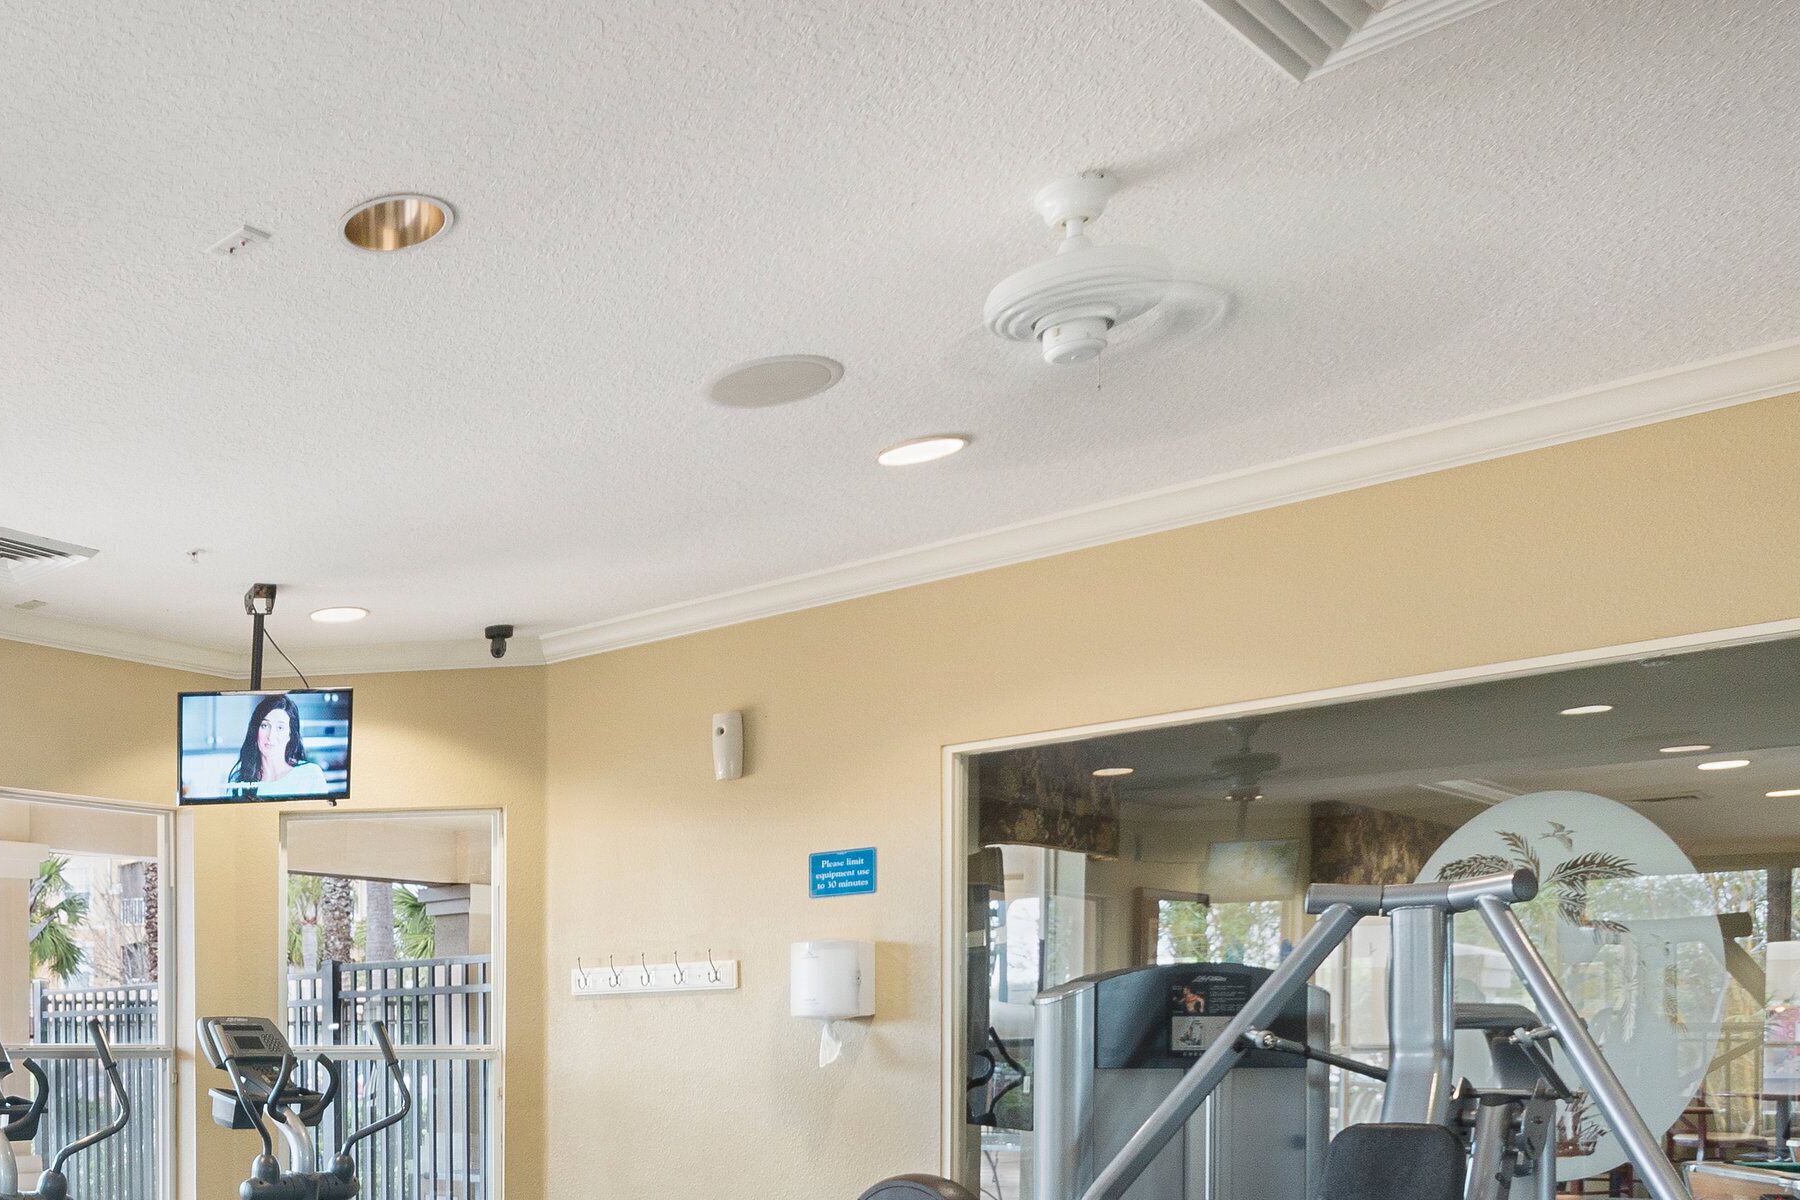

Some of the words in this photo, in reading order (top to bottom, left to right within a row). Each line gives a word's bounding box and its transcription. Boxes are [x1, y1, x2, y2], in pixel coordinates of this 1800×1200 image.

[822, 860, 844, 868] Please
[846, 857, 864, 865] limit
[816, 870, 854, 880] equipment
[838, 880, 868, 888] minutes
